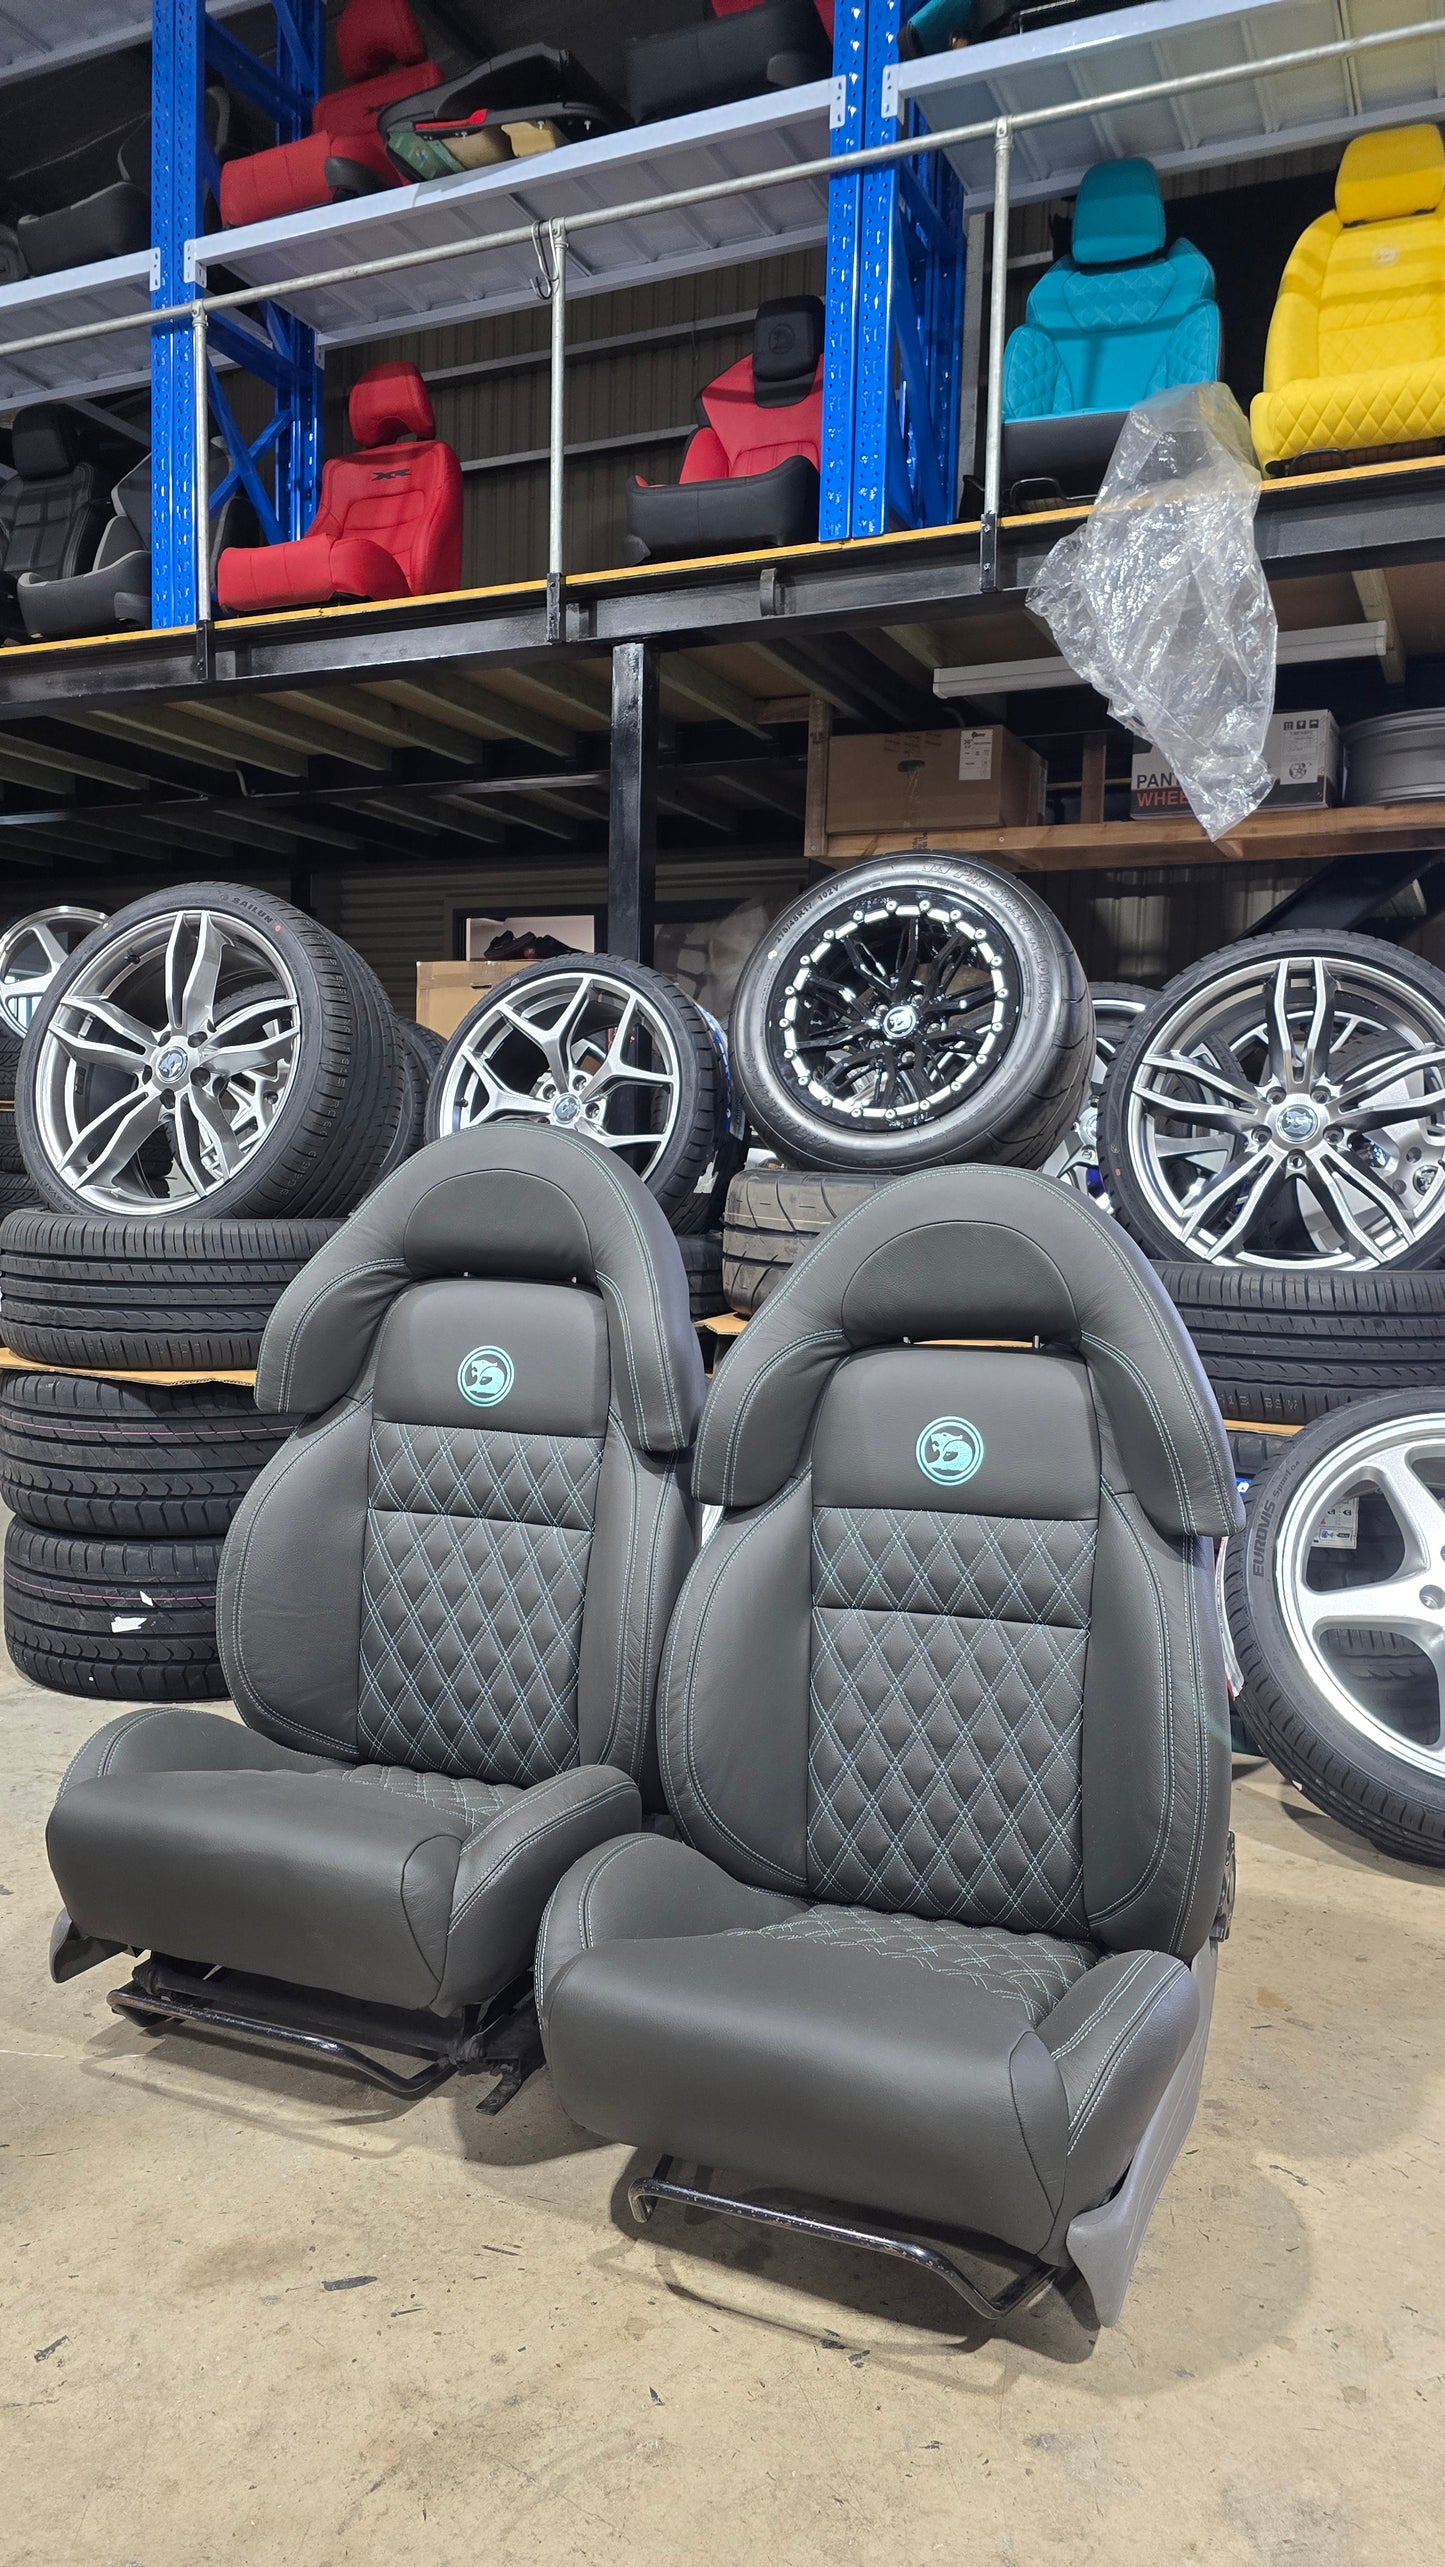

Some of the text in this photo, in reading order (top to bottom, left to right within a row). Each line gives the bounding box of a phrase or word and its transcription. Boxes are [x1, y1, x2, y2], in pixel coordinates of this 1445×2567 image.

[818, 884, 840, 901] 102V
[231, 897, 274, 923] SAILUN
[1252, 1499, 1276, 1577] EUROVIS
[1272, 1469, 1292, 1498] Sport
